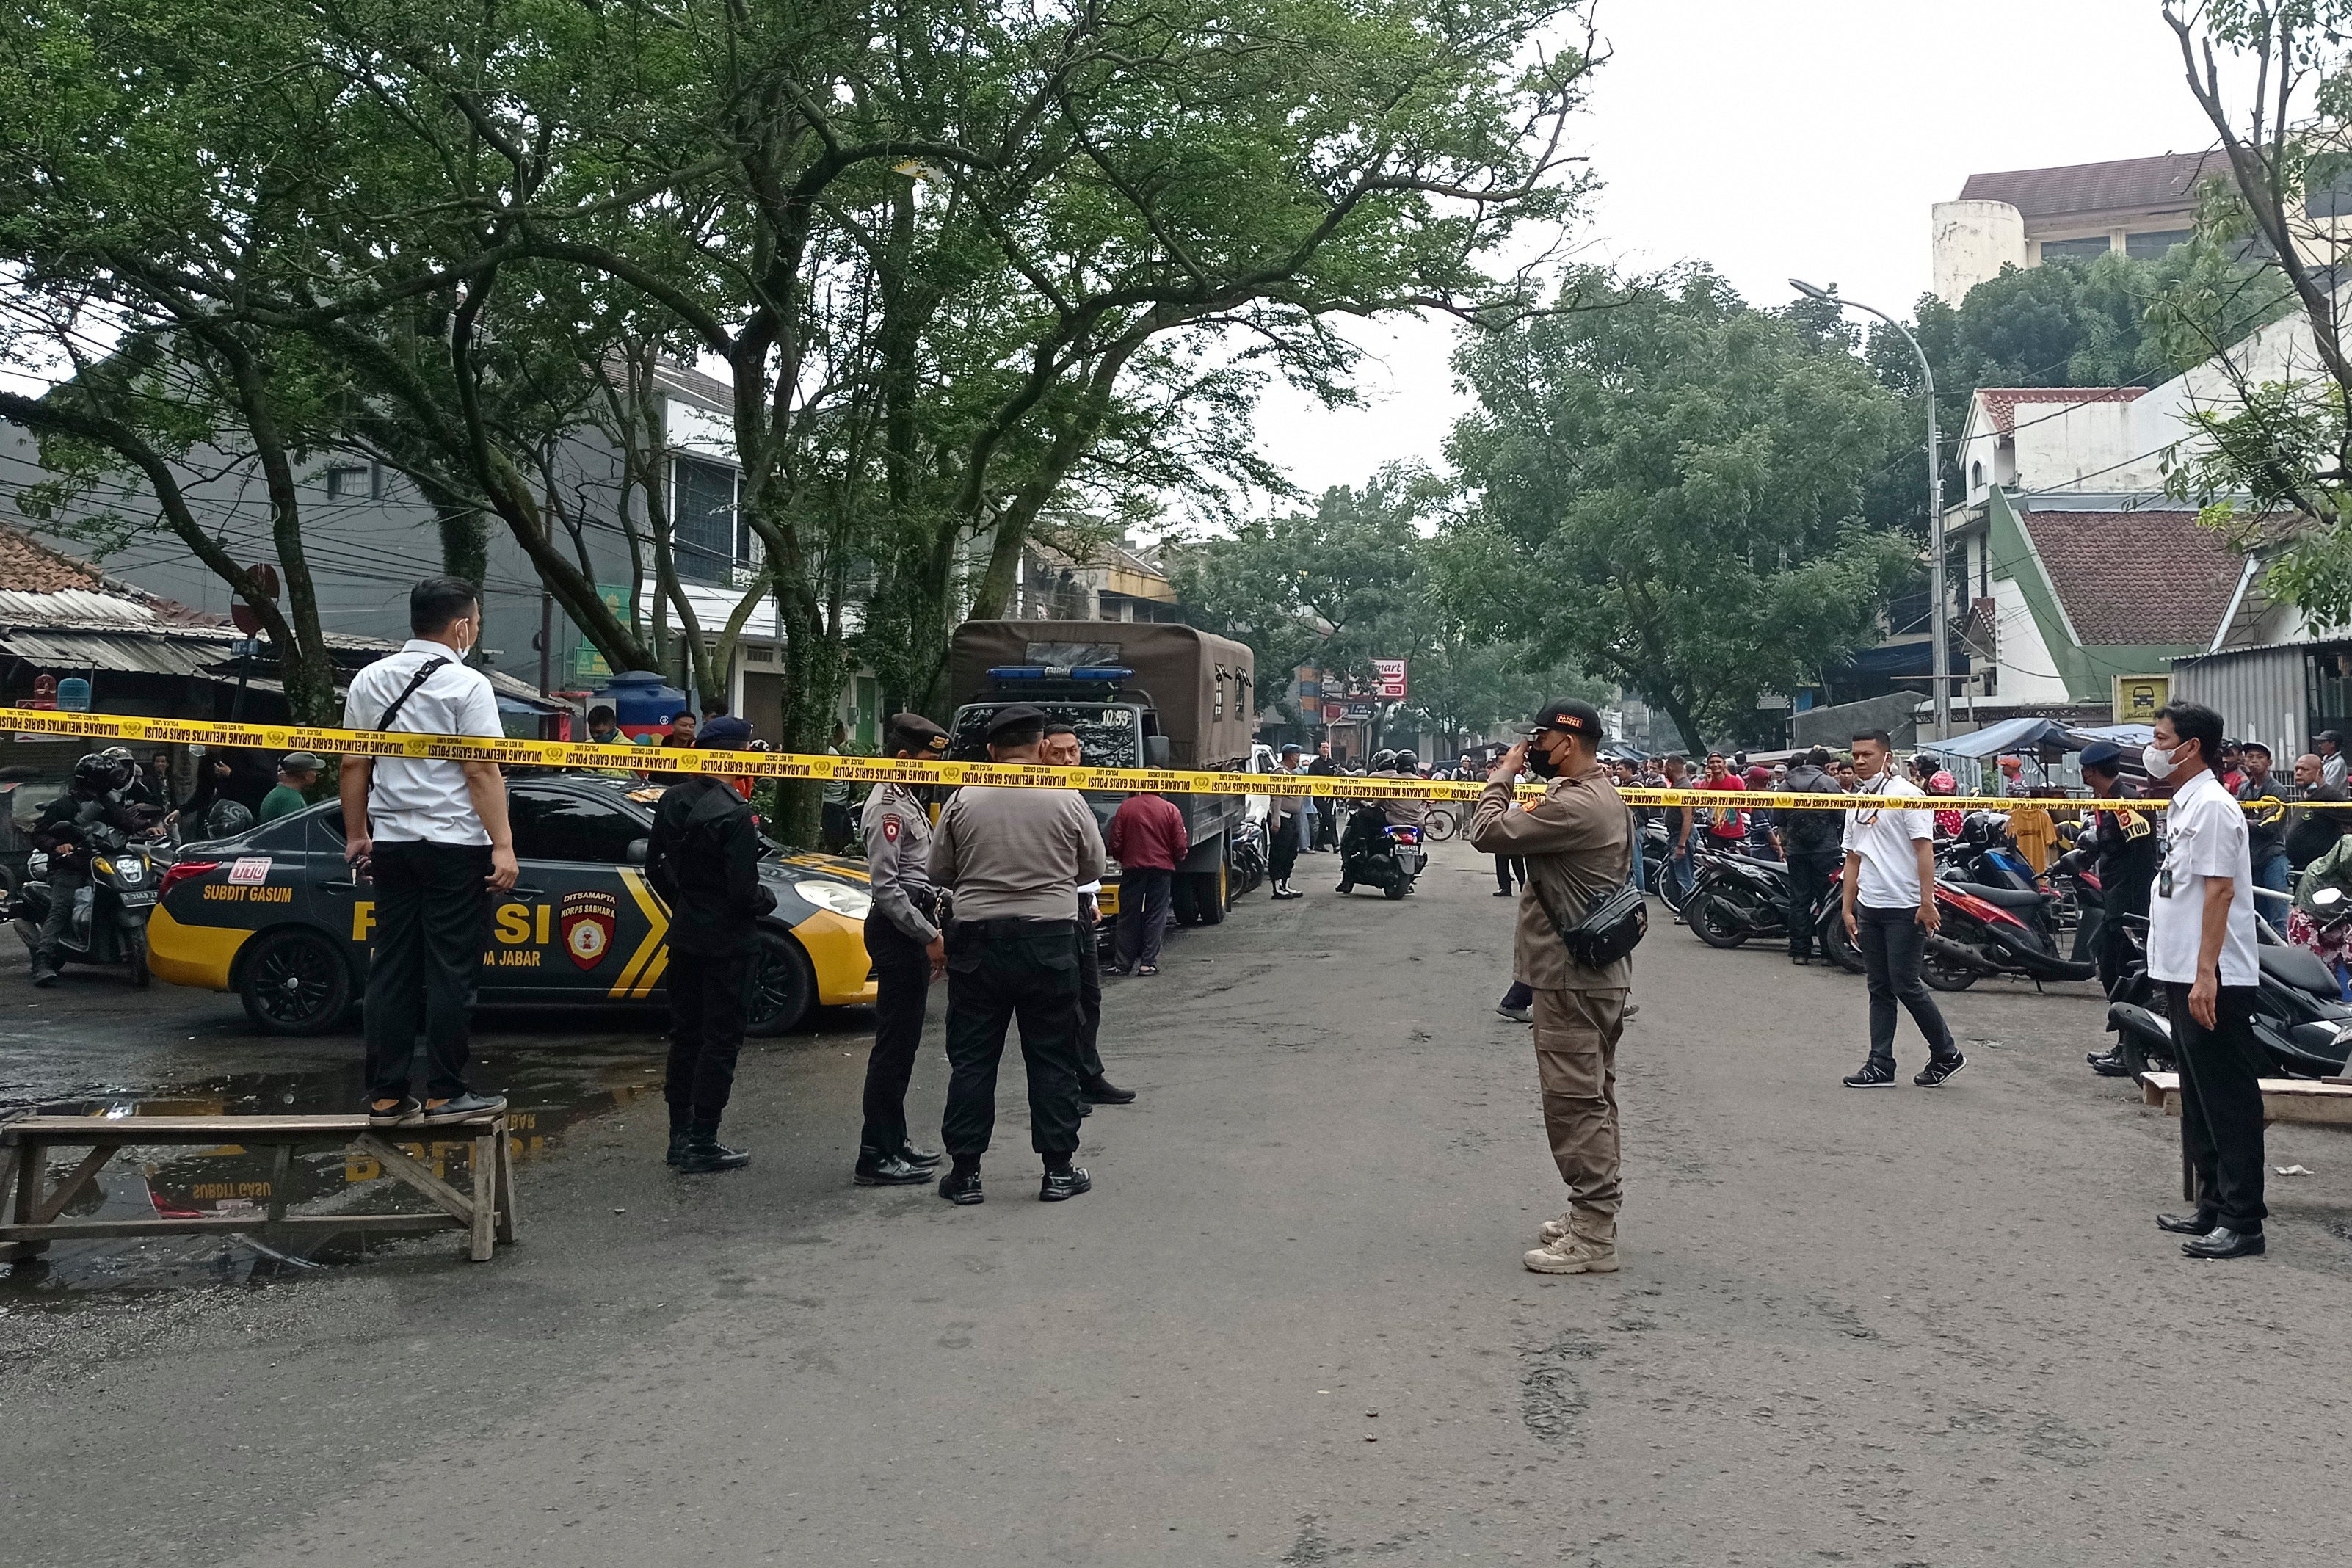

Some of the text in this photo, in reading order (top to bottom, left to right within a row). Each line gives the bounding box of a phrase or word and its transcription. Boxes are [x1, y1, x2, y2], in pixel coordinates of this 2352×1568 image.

[24, 717, 45, 730] GARIS
[48, 719, 81, 733] MELINTAS
[84, 722, 119, 736] DILARANG
[145, 726, 262, 745] DILARANG MELINTAS GARIS POLISI
[288, 736, 403, 754] DILARANG MELINTAS GARIS POLISI
[429, 745, 541, 761] DILARANG MELINTAS GARIS POLISI
[566, 752, 677, 769] DILARANG MELINTAS GARIS POLISI
[701, 759, 810, 775] DILARANG MELINTAS GARIS POLISI
[833, 766, 939, 781] DILARANG MELINTAS GARIS POLISI
[962, 772, 1066, 787] DILARANG MELINTAS GARIS POLISI
[1089, 777, 1190, 791] DILARANG MELINTAS GARIS POLISI
[1212, 781, 1311, 794] DILARANG MELINTAS GARIS POLISI
[1333, 785, 1430, 798] DILARANG MELINTAS GARIS POLISI
[235, 865, 265, 879] 110
[203, 884, 292, 903] SUBDIT GASUM
[563, 892, 616, 904] DITSAMAPTA
[561, 904, 615, 919] KORPS SABHARA
[499, 951, 540, 967] JABAR
